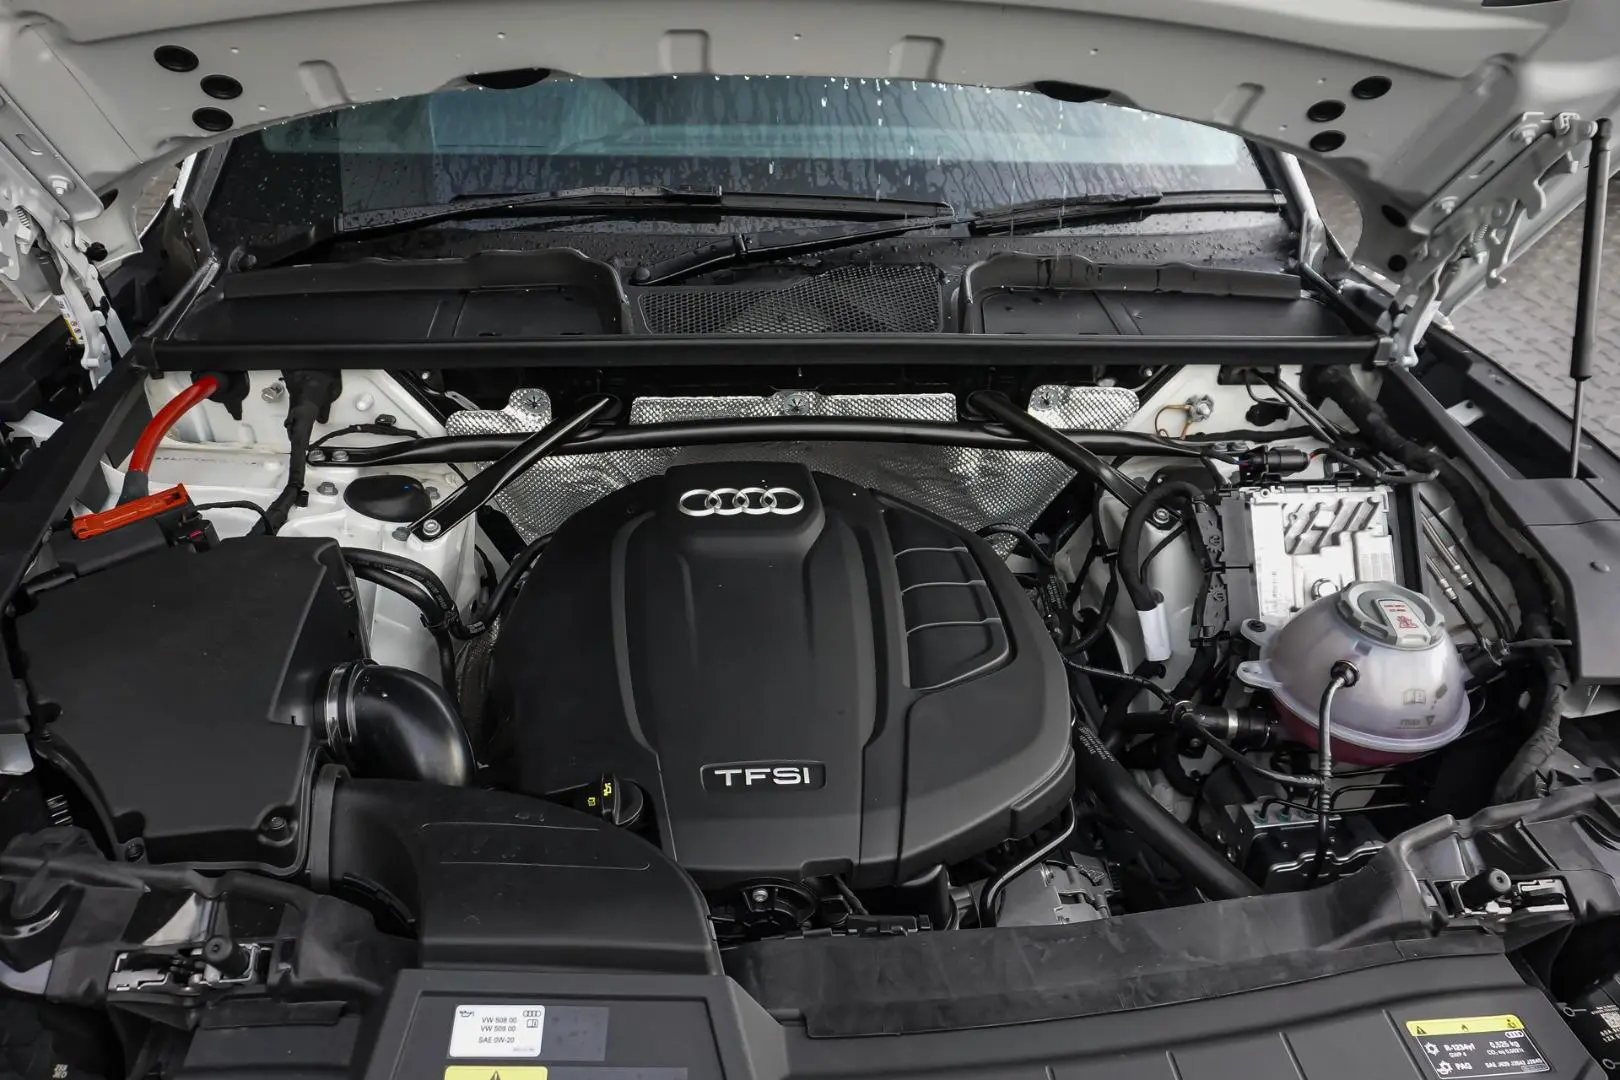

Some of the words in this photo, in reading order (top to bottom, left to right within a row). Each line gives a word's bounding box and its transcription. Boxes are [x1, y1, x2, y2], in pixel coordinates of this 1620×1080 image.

[714, 767, 811, 786] TFSI
[478, 1036, 493, 1044] SAE
[494, 1036, 515, 1044] 0W-20
[1454, 1062, 1473, 1070] PAG
